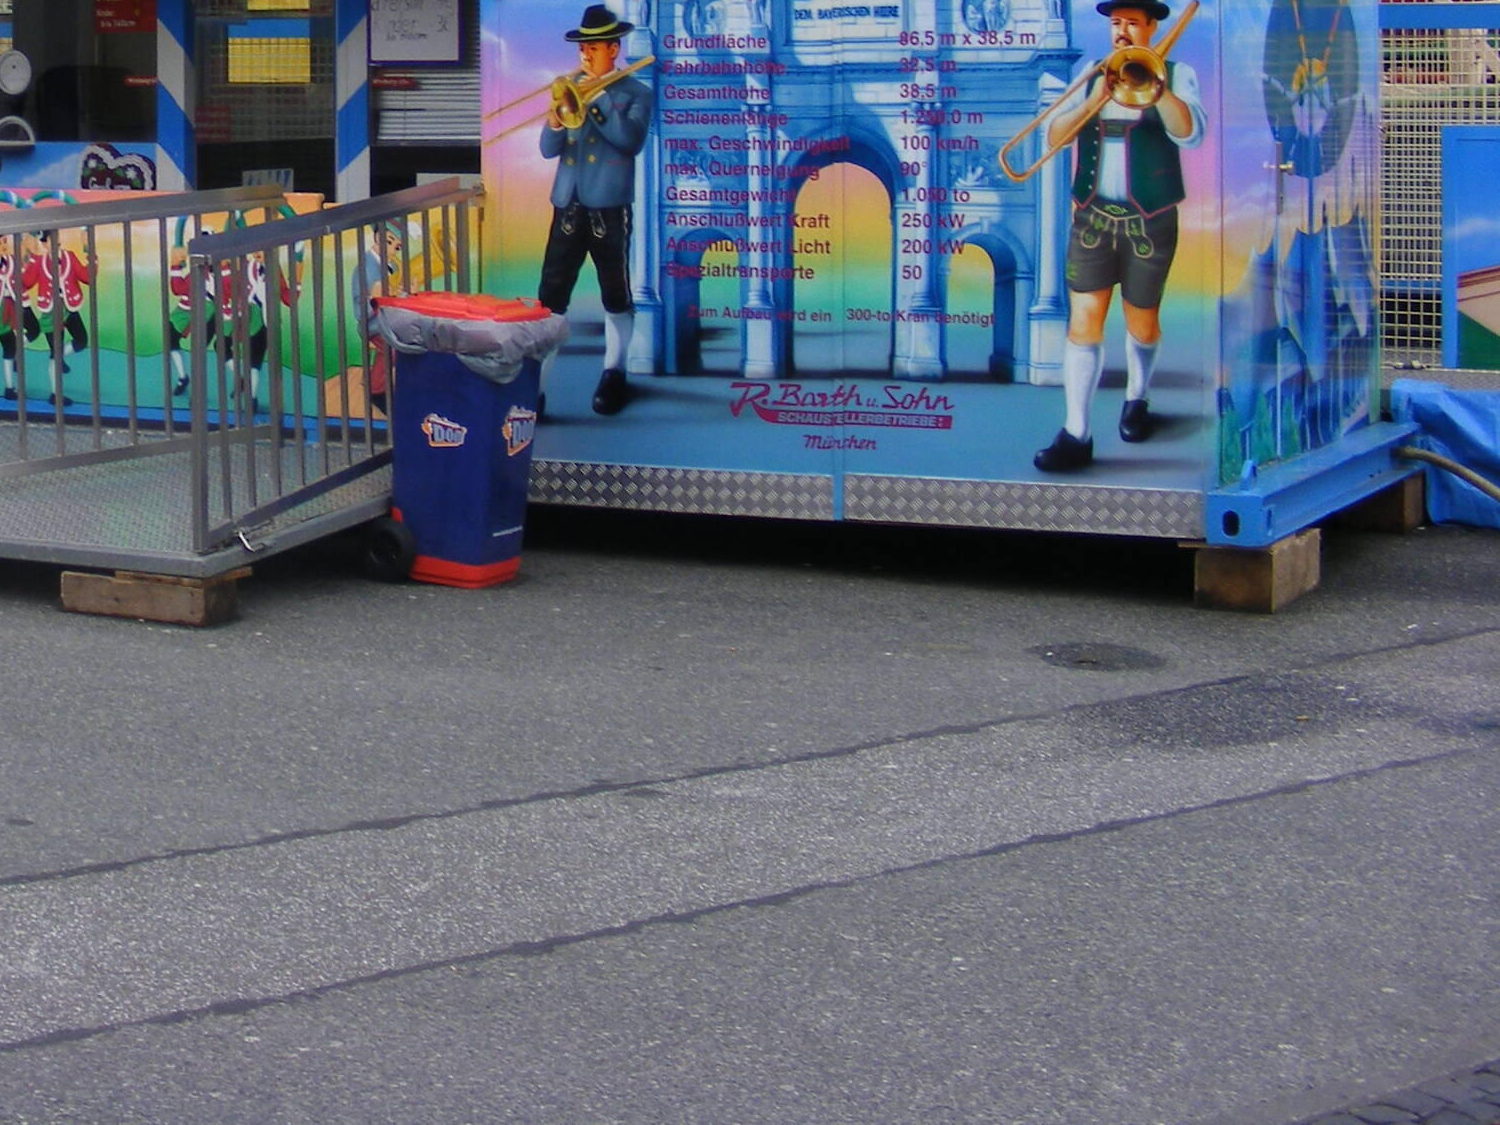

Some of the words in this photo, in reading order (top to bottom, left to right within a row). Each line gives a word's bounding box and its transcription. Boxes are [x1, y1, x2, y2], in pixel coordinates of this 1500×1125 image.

[794, 8, 813, 20] DEM
[663, 33, 767, 49] Grundfläche
[940, 33, 956, 45] m
[962, 33, 972, 45] x
[1020, 33, 1036, 45] m
[662, 59, 786, 75] Fahrbahnhöhe
[940, 59, 957, 72] m
[663, 84, 770, 100] Gesamthöhe
[941, 86, 957, 98] m
[663, 109, 789, 129] Schienenlänge
[967, 112, 983, 124] m
[664, 137, 703, 150] max.
[708, 134, 850, 156] Geschwindigkeit
[901, 135, 931, 150] 100
[936, 135, 979, 151] km/h
[664, 162, 703, 175] max.
[708, 161, 821, 181] Querneigung
[665, 186, 797, 206] Gesamtgewicht
[953, 189, 971, 203] to
[666, 211, 783, 228] Anschlußwert
[790, 213, 830, 229] Kraft
[901, 213, 933, 229] 250
[937, 213, 966, 229] kW
[666, 236, 783, 253] Anschlußwert
[791, 238, 831, 255] Licht
[901, 239, 933, 254] 200
[937, 239, 966, 255] kW
[665, 261, 816, 281] Spezialtransporte
[902, 265, 923, 280] 50
[687, 304, 718, 318] Zum
[722, 306, 773, 321] Aufbau
[810, 309, 832, 322] ein
[845, 307, 891, 322] 300-to
[895, 310, 930, 323] Kran
[934, 310, 996, 328] benötigt
[771, 383, 863, 407] Barth
[866, 396, 879, 408] u.
[881, 385, 955, 411] Sohn
[802, 434, 877, 451] München
